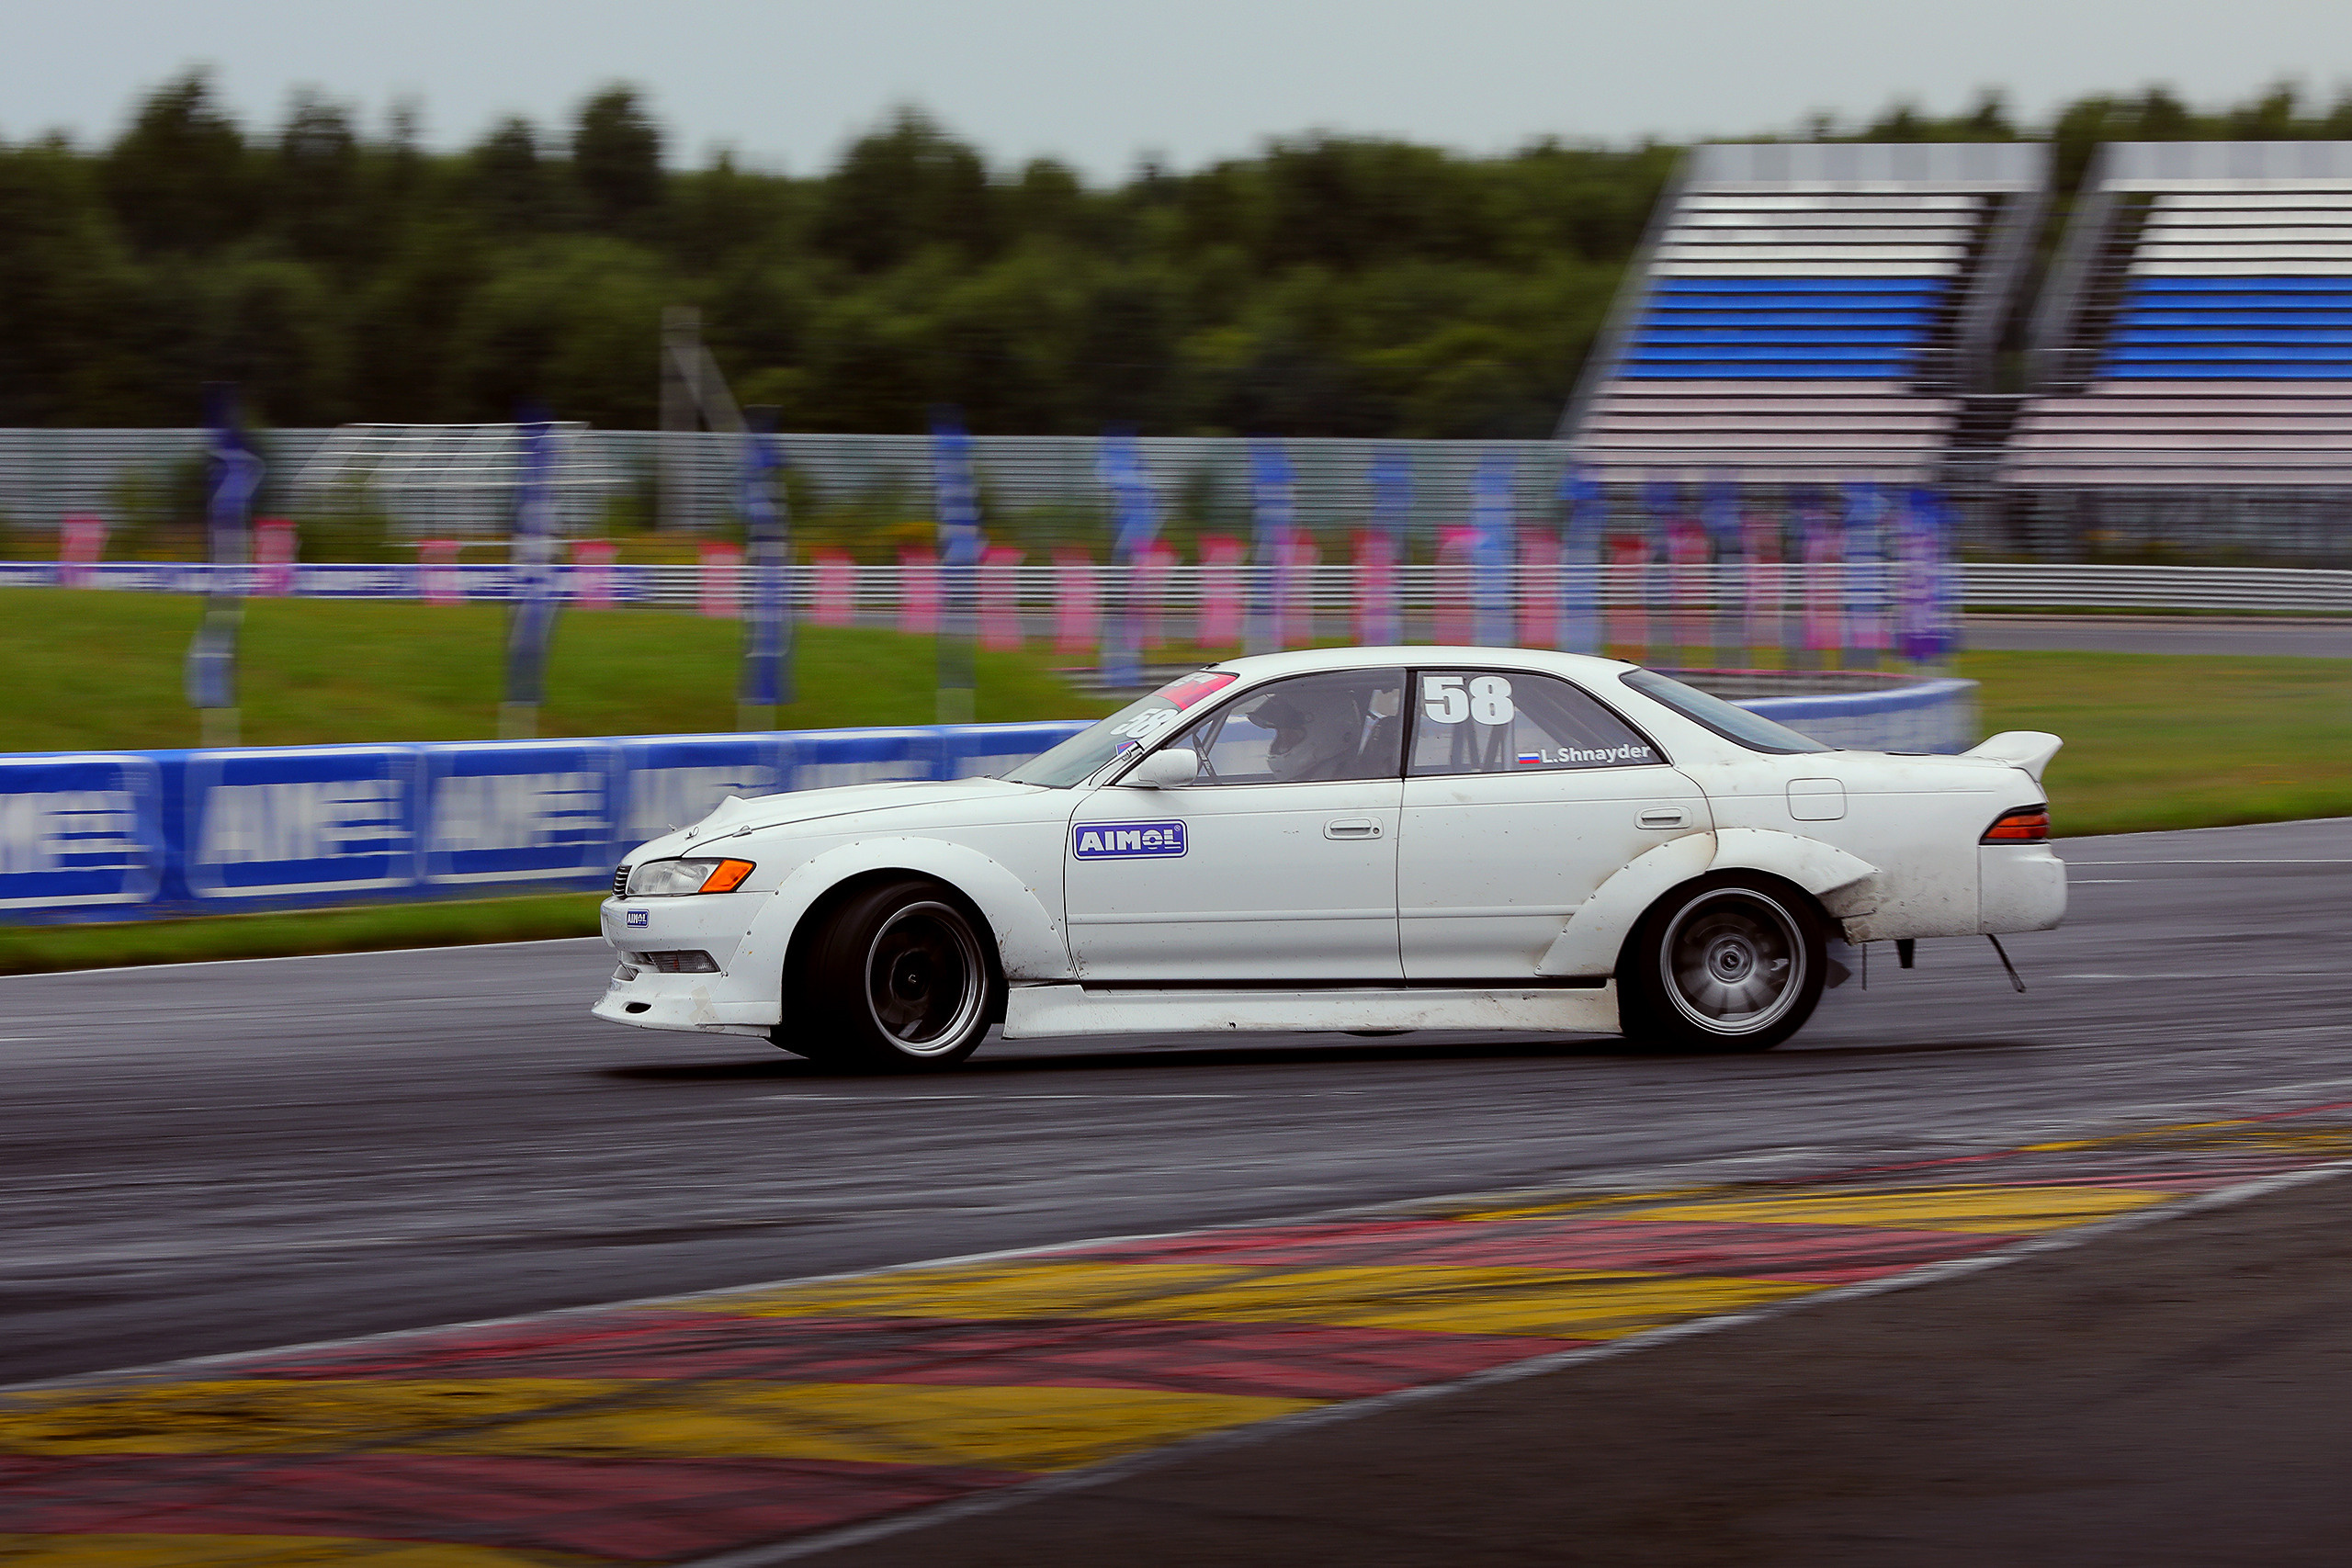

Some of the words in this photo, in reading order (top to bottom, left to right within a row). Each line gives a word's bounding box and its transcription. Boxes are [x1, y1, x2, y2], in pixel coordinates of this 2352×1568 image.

[1422, 675, 1514, 726] 58
[1110, 708, 1179, 739] 58
[1540, 744, 1652, 763] L.Shnayder
[1079, 829, 1182, 852] AIMOL
